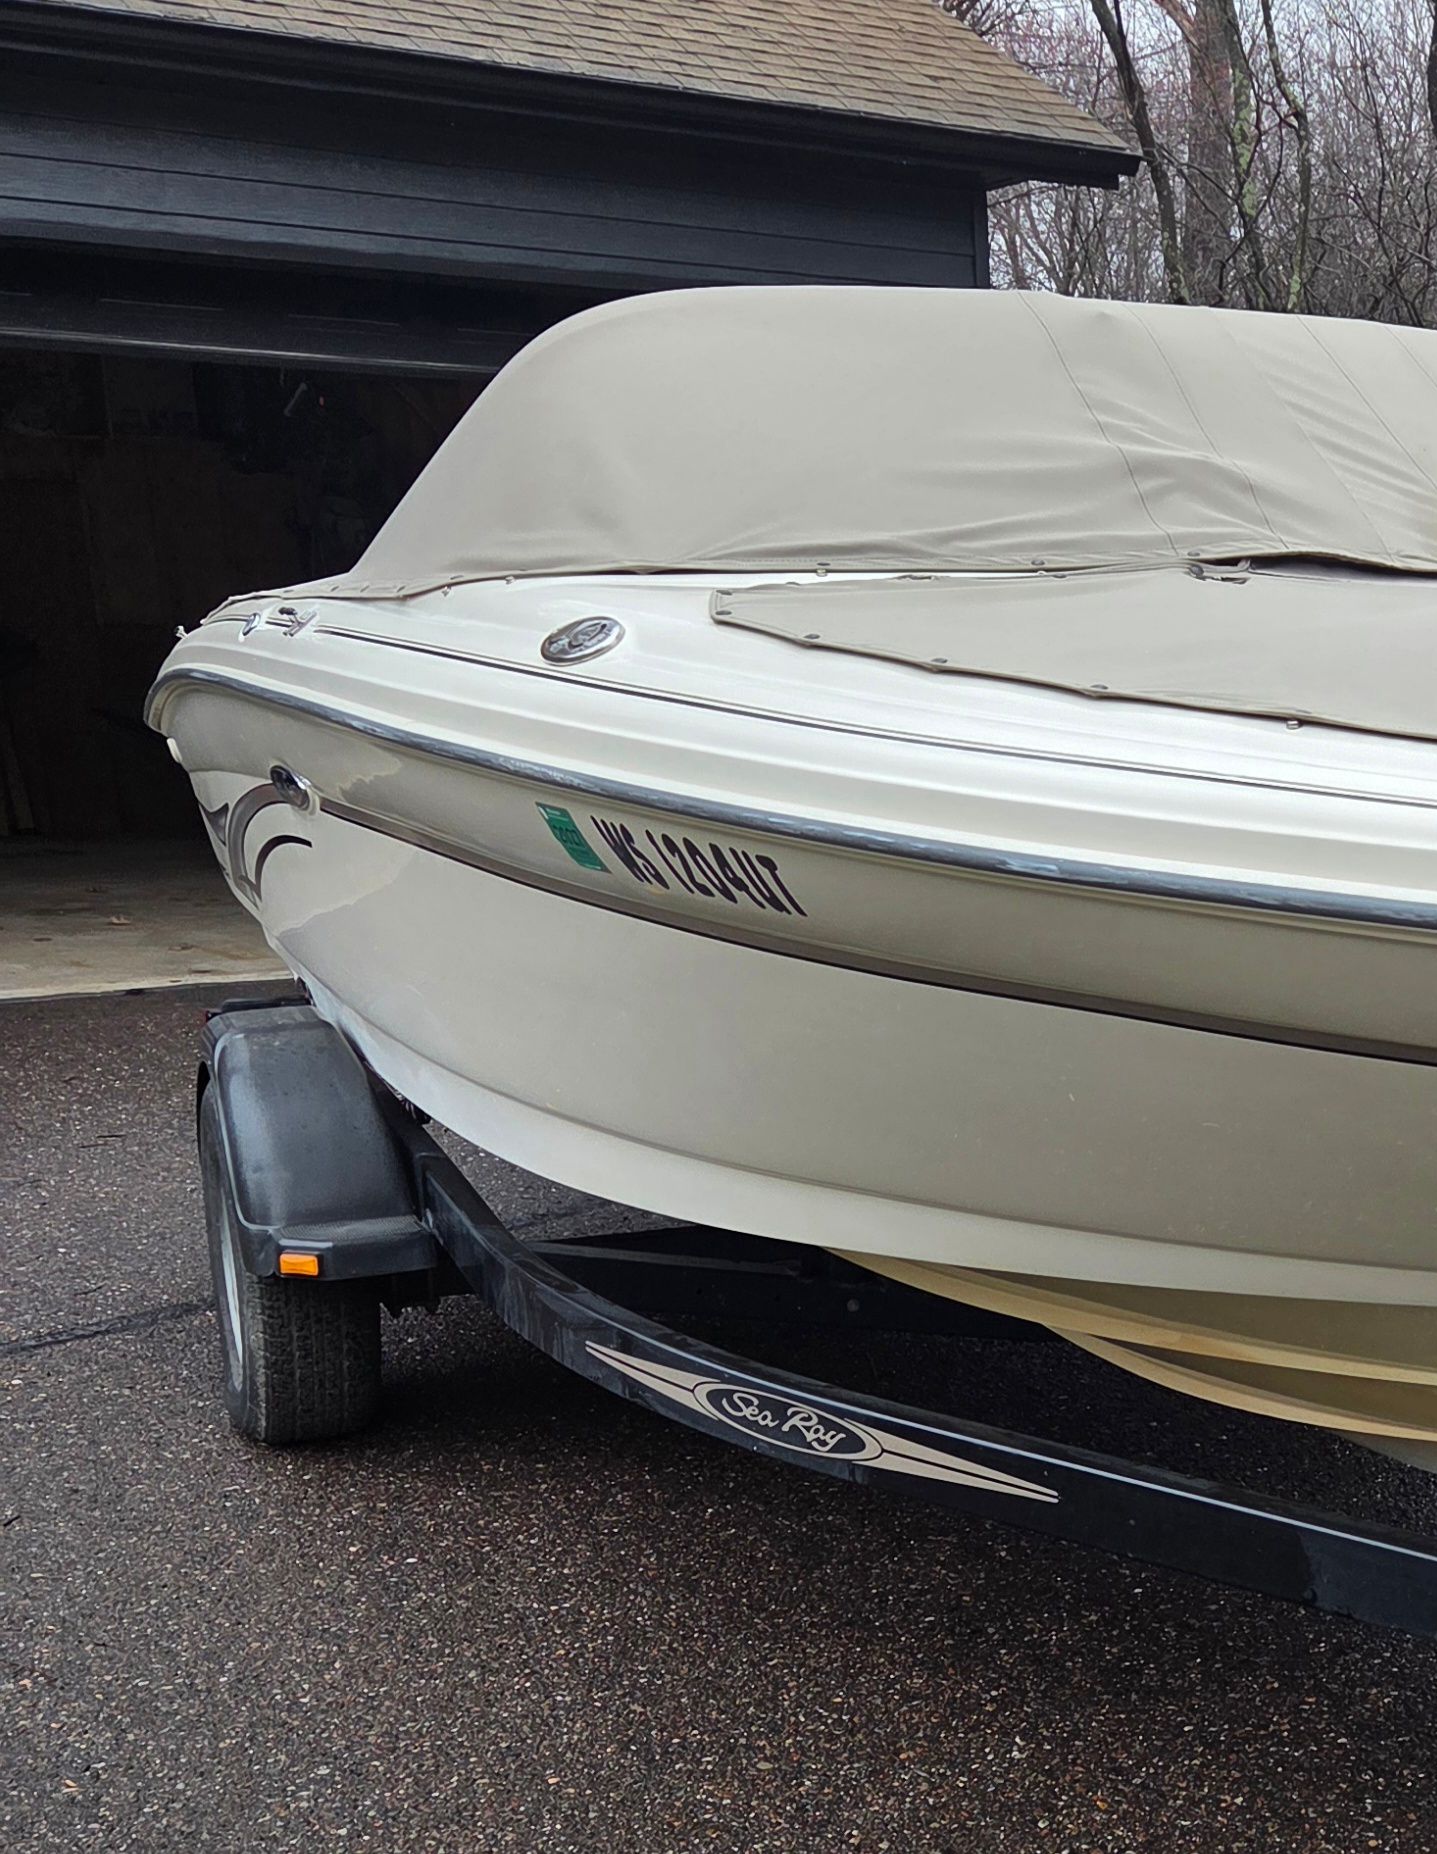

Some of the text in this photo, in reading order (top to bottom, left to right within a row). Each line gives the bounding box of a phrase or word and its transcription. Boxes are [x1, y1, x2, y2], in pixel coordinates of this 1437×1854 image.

[589, 815, 670, 890] WS
[721, 1392, 847, 1452] Sea Ray
